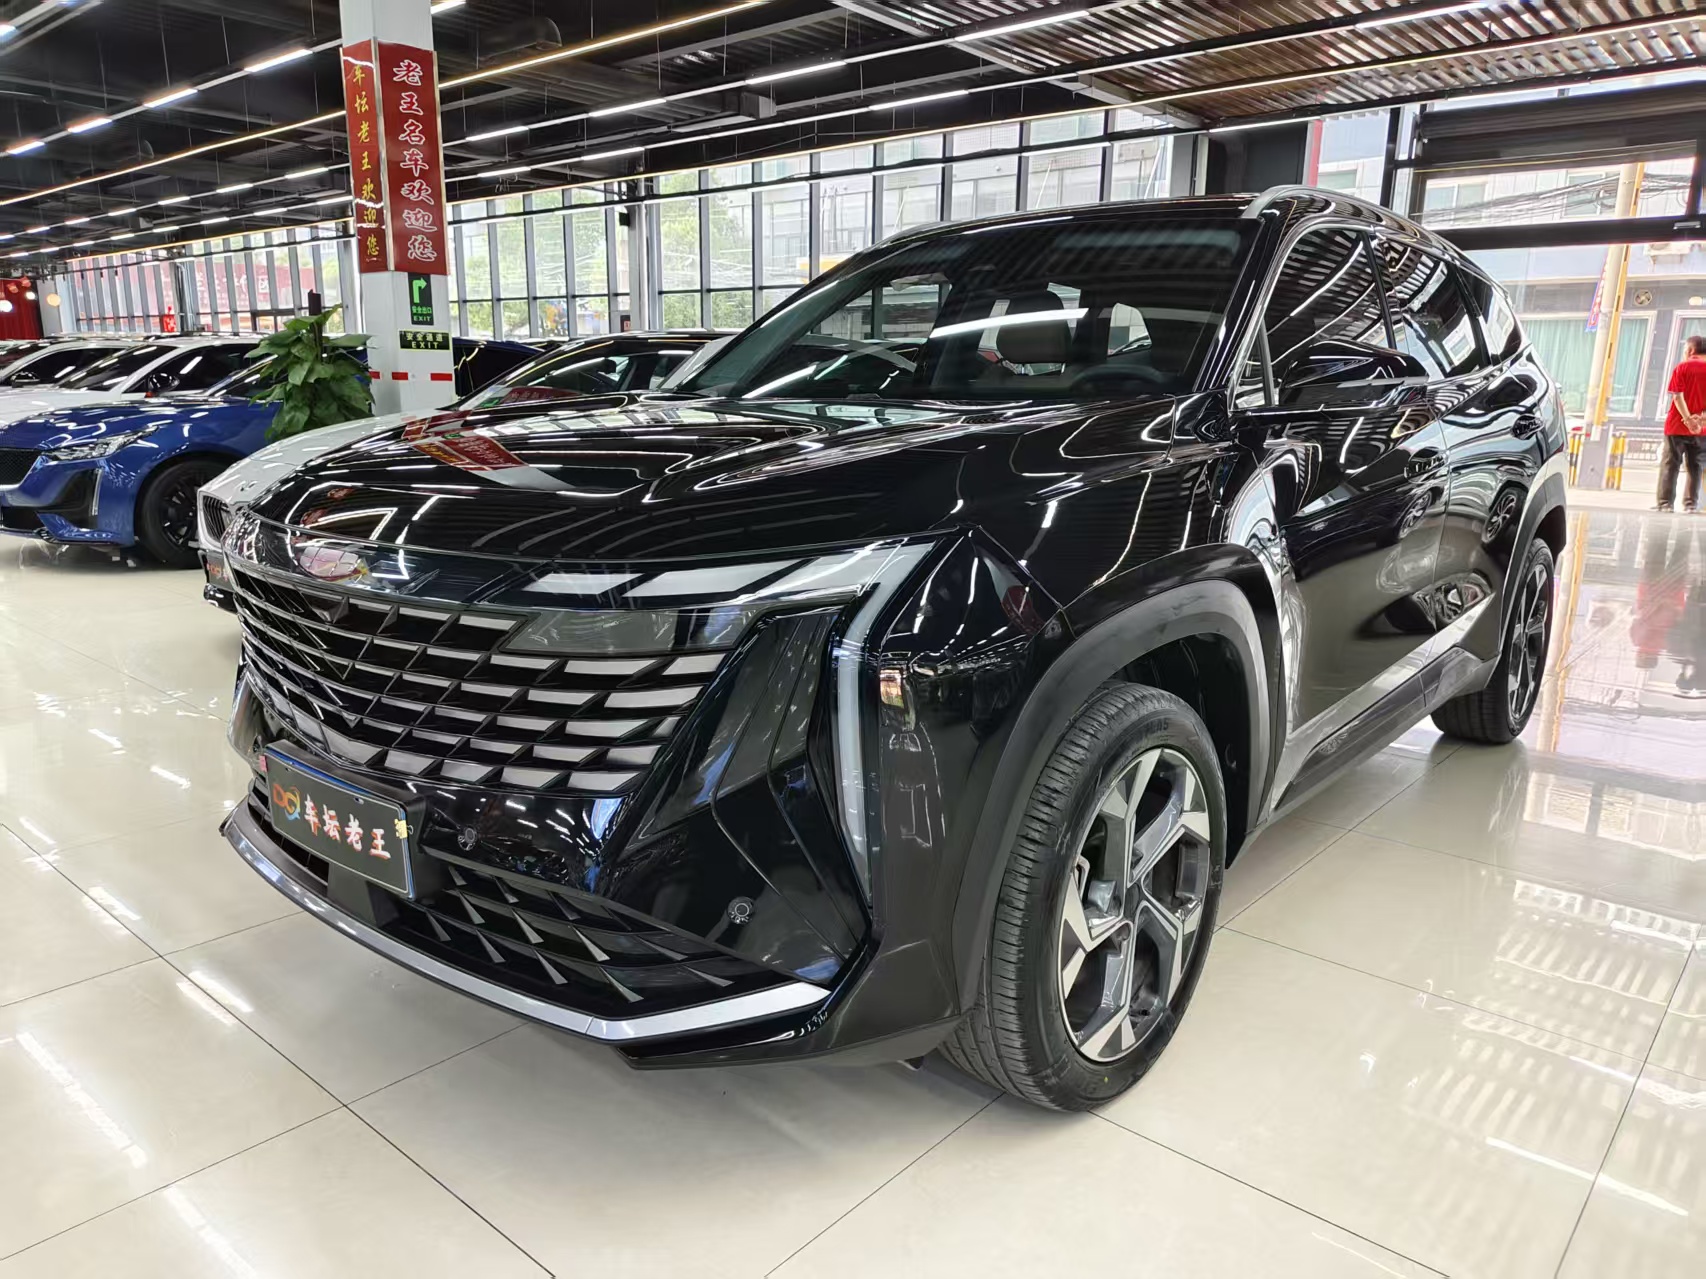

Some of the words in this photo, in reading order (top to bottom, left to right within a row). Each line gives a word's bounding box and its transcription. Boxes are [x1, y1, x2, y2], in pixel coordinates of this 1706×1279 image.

[352, 65, 379, 256] 车坛老王欢迎您
[393, 60, 438, 261] 老王名车欢迎您
[405, 332, 443, 341] 安全通道
[411, 305, 432, 314] 安全出口
[304, 794, 391, 860] 车坛老王
